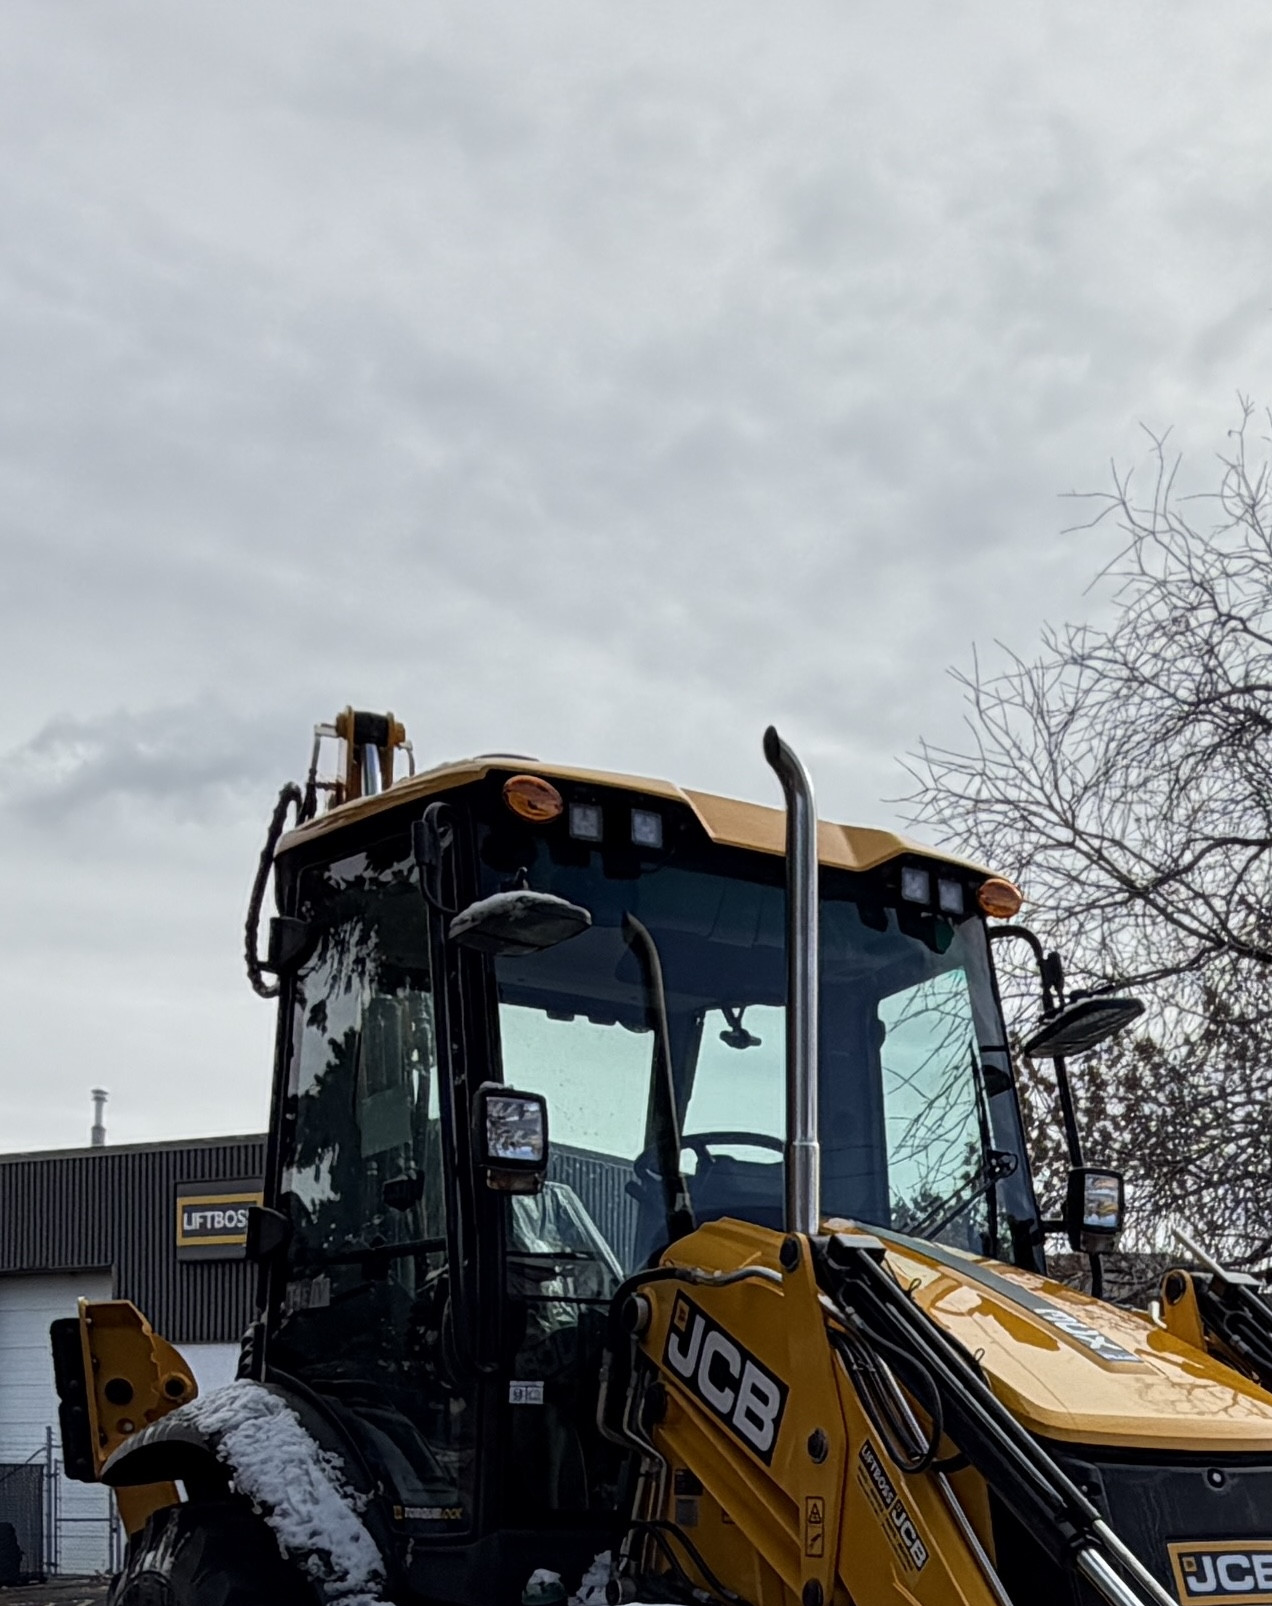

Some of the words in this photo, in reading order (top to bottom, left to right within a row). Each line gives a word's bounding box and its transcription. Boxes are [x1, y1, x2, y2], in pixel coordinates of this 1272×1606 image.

[183, 1209, 249, 1230] LIFTBOS
[668, 1314, 781, 1452] JCB
[891, 1508, 927, 1568] JCB
